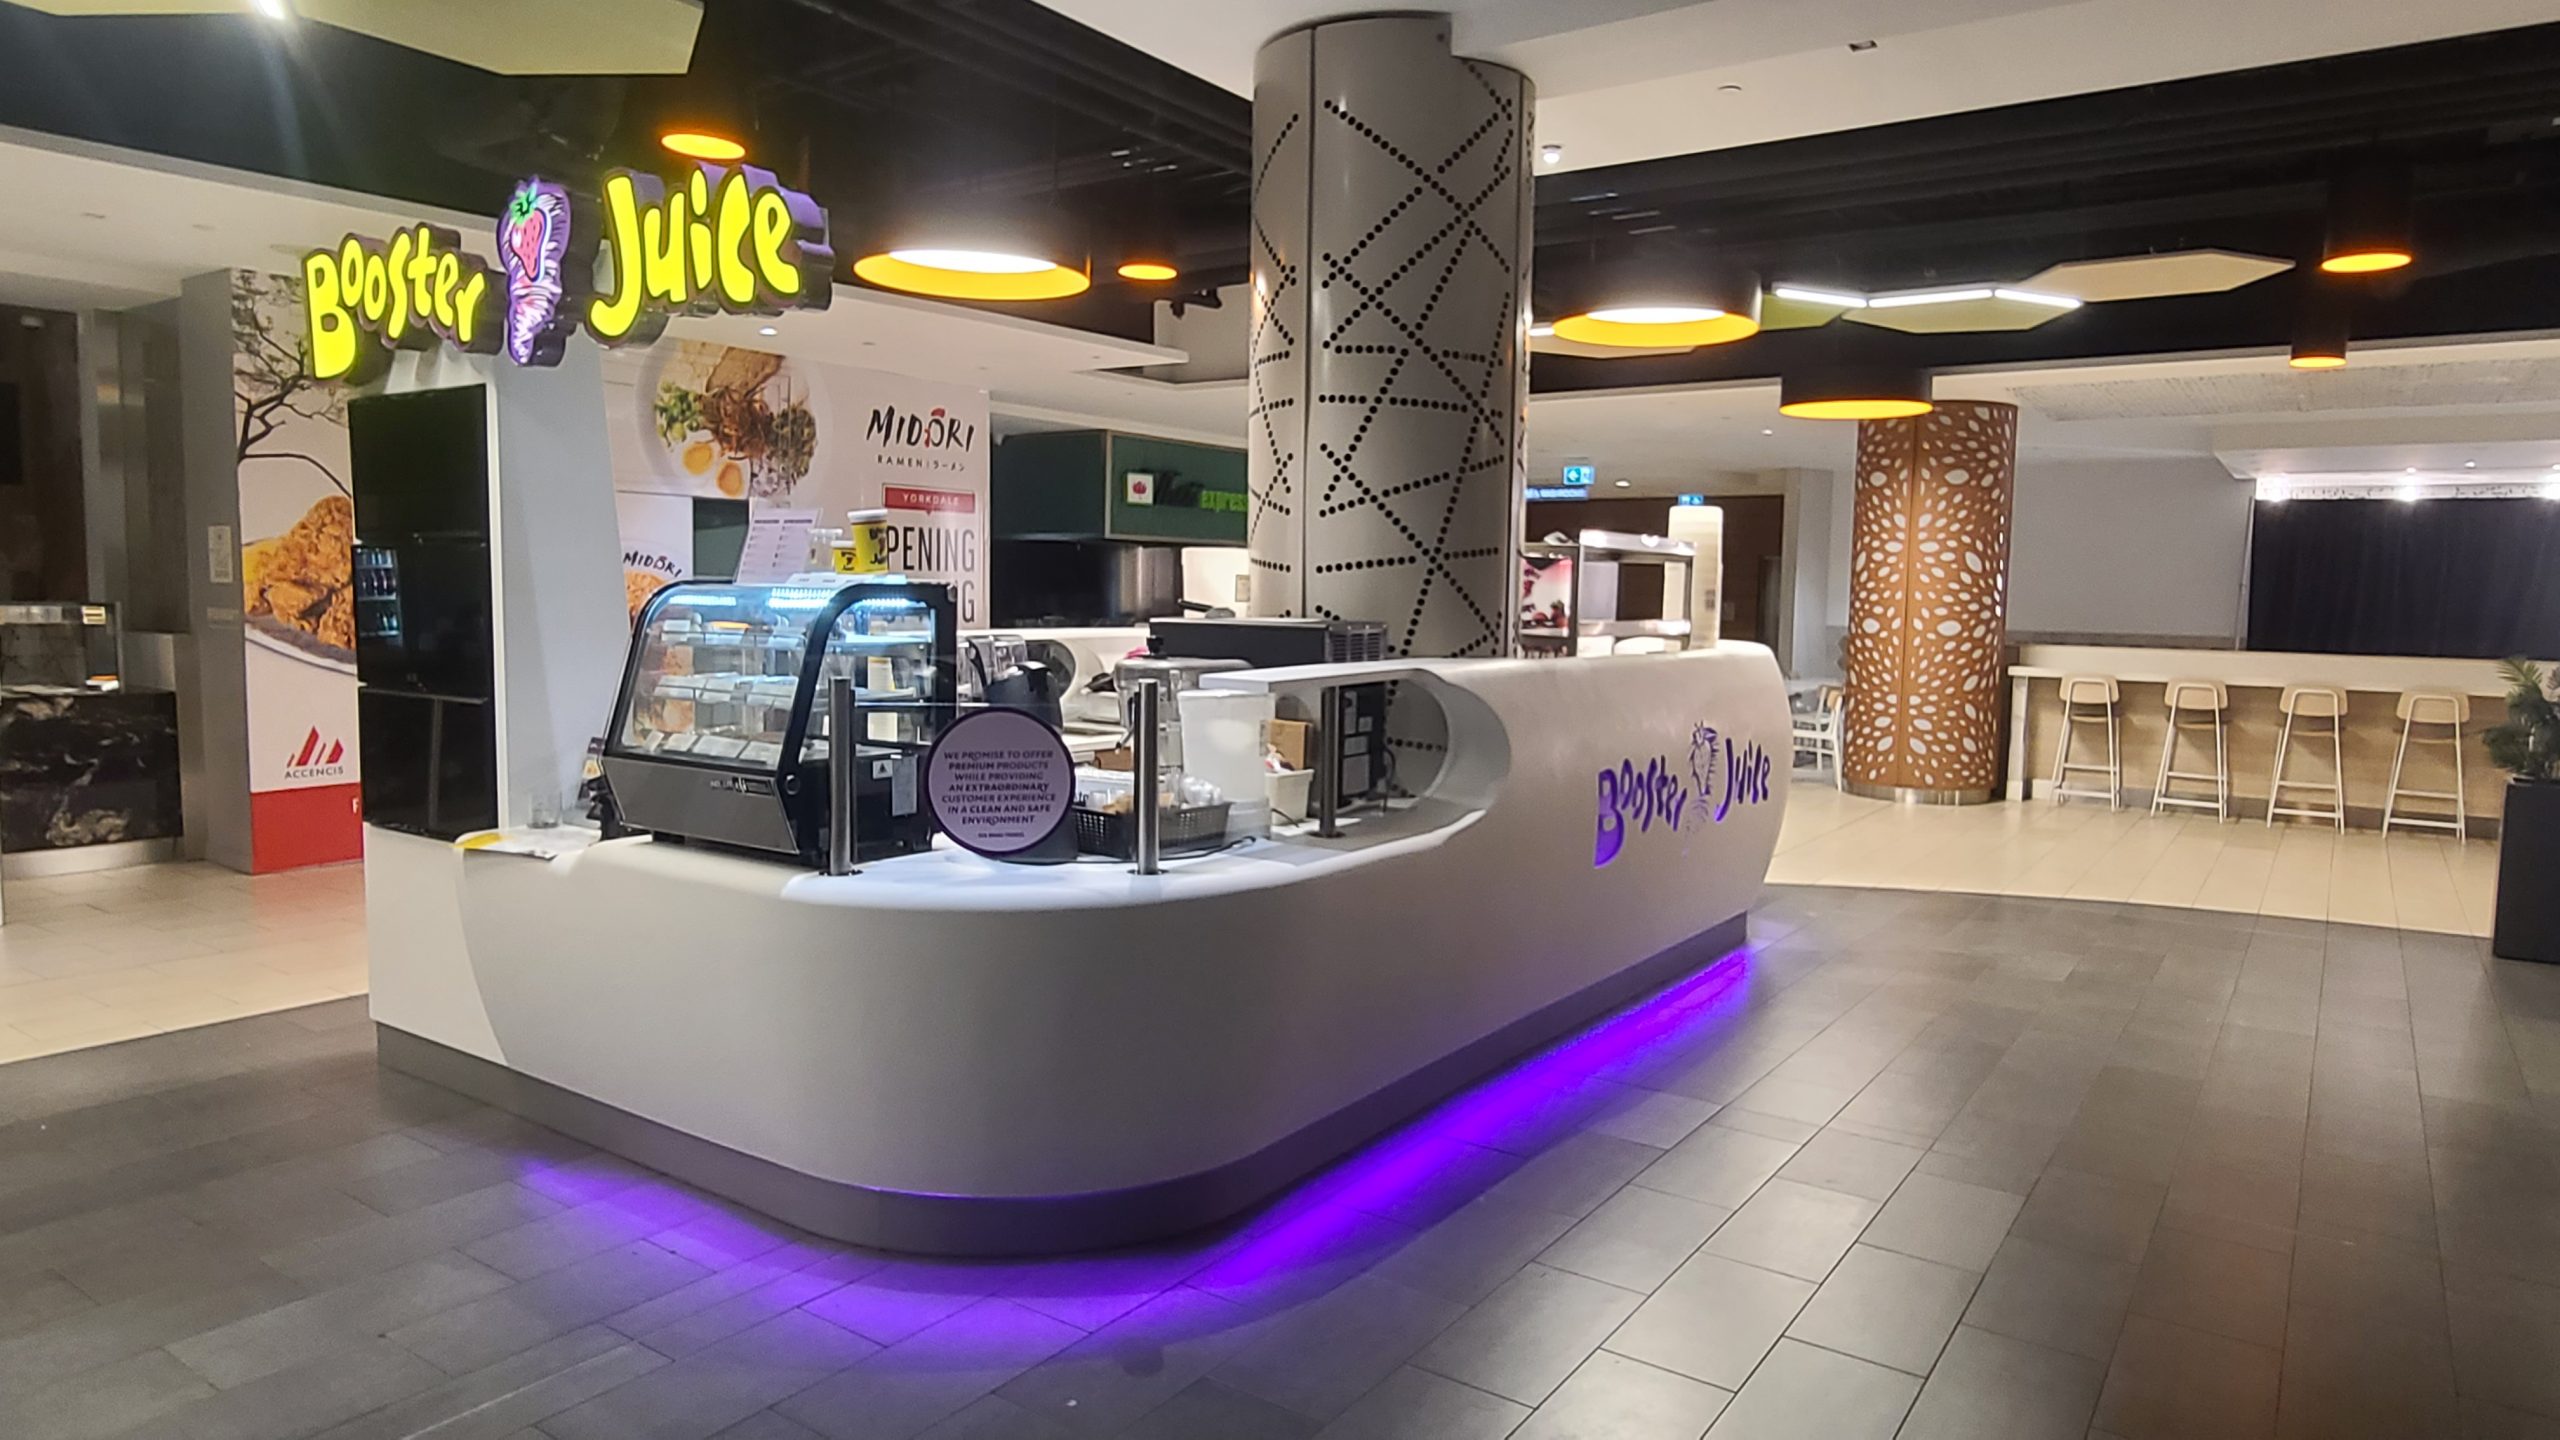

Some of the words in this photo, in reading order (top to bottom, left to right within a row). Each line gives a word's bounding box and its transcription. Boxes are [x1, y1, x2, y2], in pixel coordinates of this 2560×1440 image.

[307, 226, 486, 379] Booster
[590, 168, 800, 337] Juice
[903, 491, 960, 507] YORKDALE
[886, 526, 975, 573] PENING
[944, 751, 959, 760] WE
[961, 751, 1005, 761] PROMISE
[1007, 751, 1021, 759] TO
[1022, 750, 1053, 759] OFFER
[949, 762, 995, 770] PREMIUM
[996, 761, 1048, 770] PRODUCTS
[284, 765, 345, 779] ACCENCIS
[954, 773, 985, 781] WHILE
[988, 772, 1044, 781] PROVIDING
[949, 783, 964, 792] AN
[965, 783, 1050, 793] EXTRAORDINARY
[942, 794, 996, 803] CUSTOMER
[997, 793, 1056, 802] EXPERIENCE
[1594, 755, 1687, 869] Booster
[1714, 737, 1770, 822] Juice
[947, 806, 959, 814] IN
[960, 806, 968, 814] A
[969, 805, 1001, 813] CLEAN
[1003, 805, 1026, 813] AND
[1027, 804, 1051, 812] SAFE
[961, 815, 1036, 826] ENVIRONMENT
